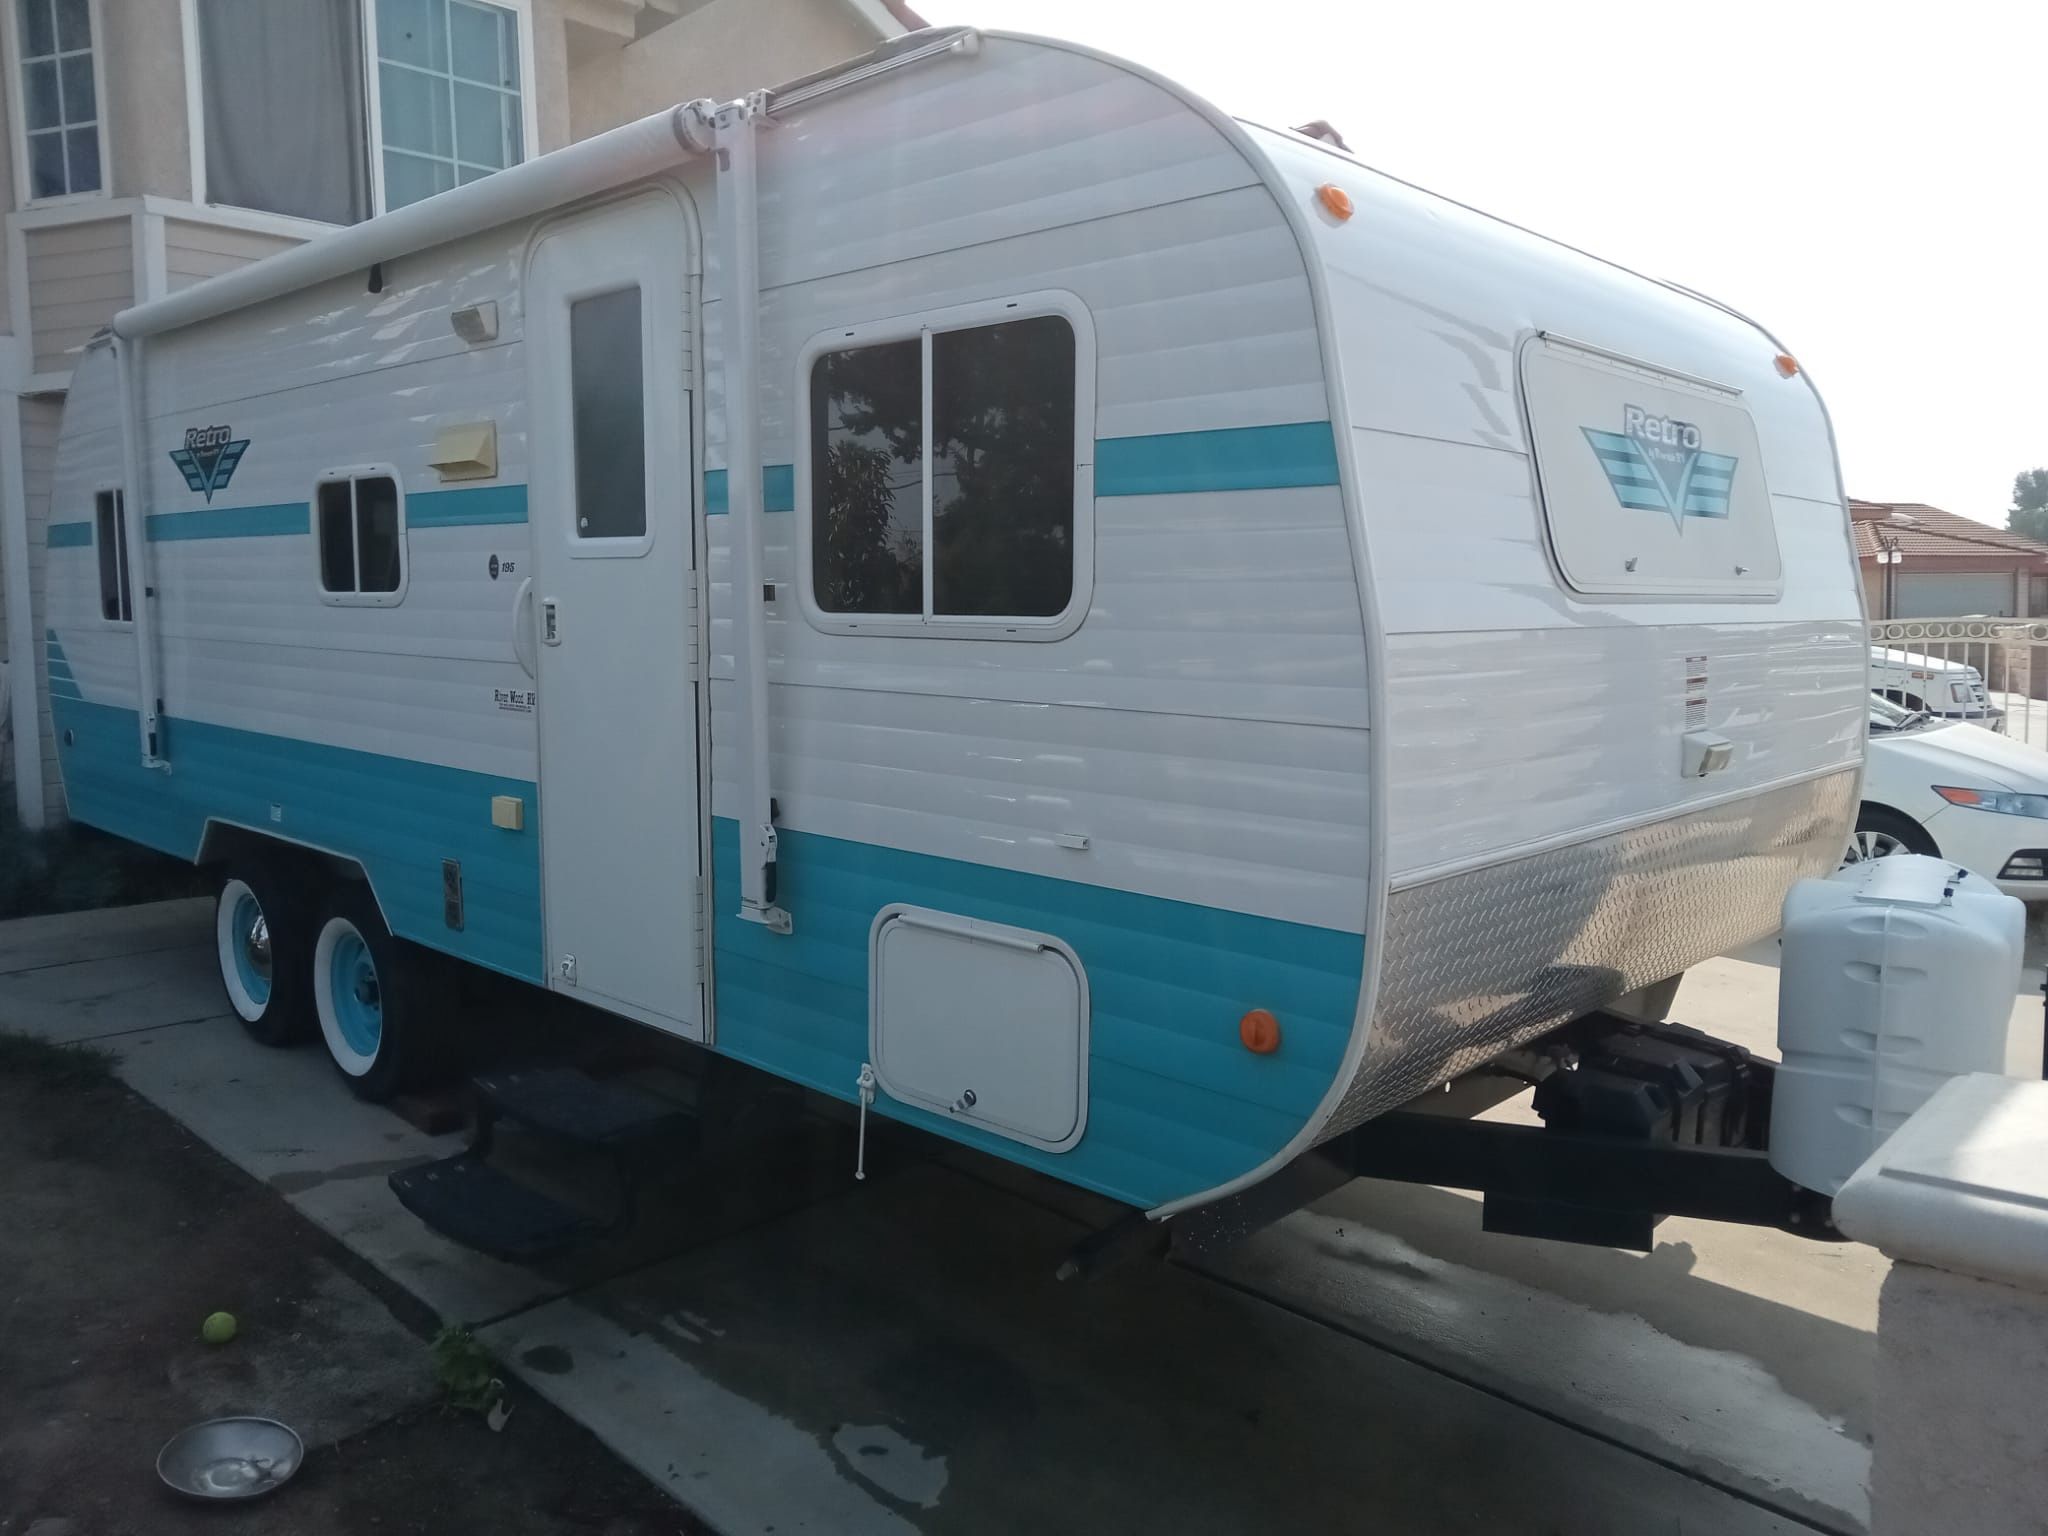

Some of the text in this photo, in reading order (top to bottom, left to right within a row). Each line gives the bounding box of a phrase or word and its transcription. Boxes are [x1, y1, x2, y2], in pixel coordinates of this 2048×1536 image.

[185, 426, 230, 449] Retro
[1625, 404, 1700, 449] Retro
[502, 562, 515, 573] 195
